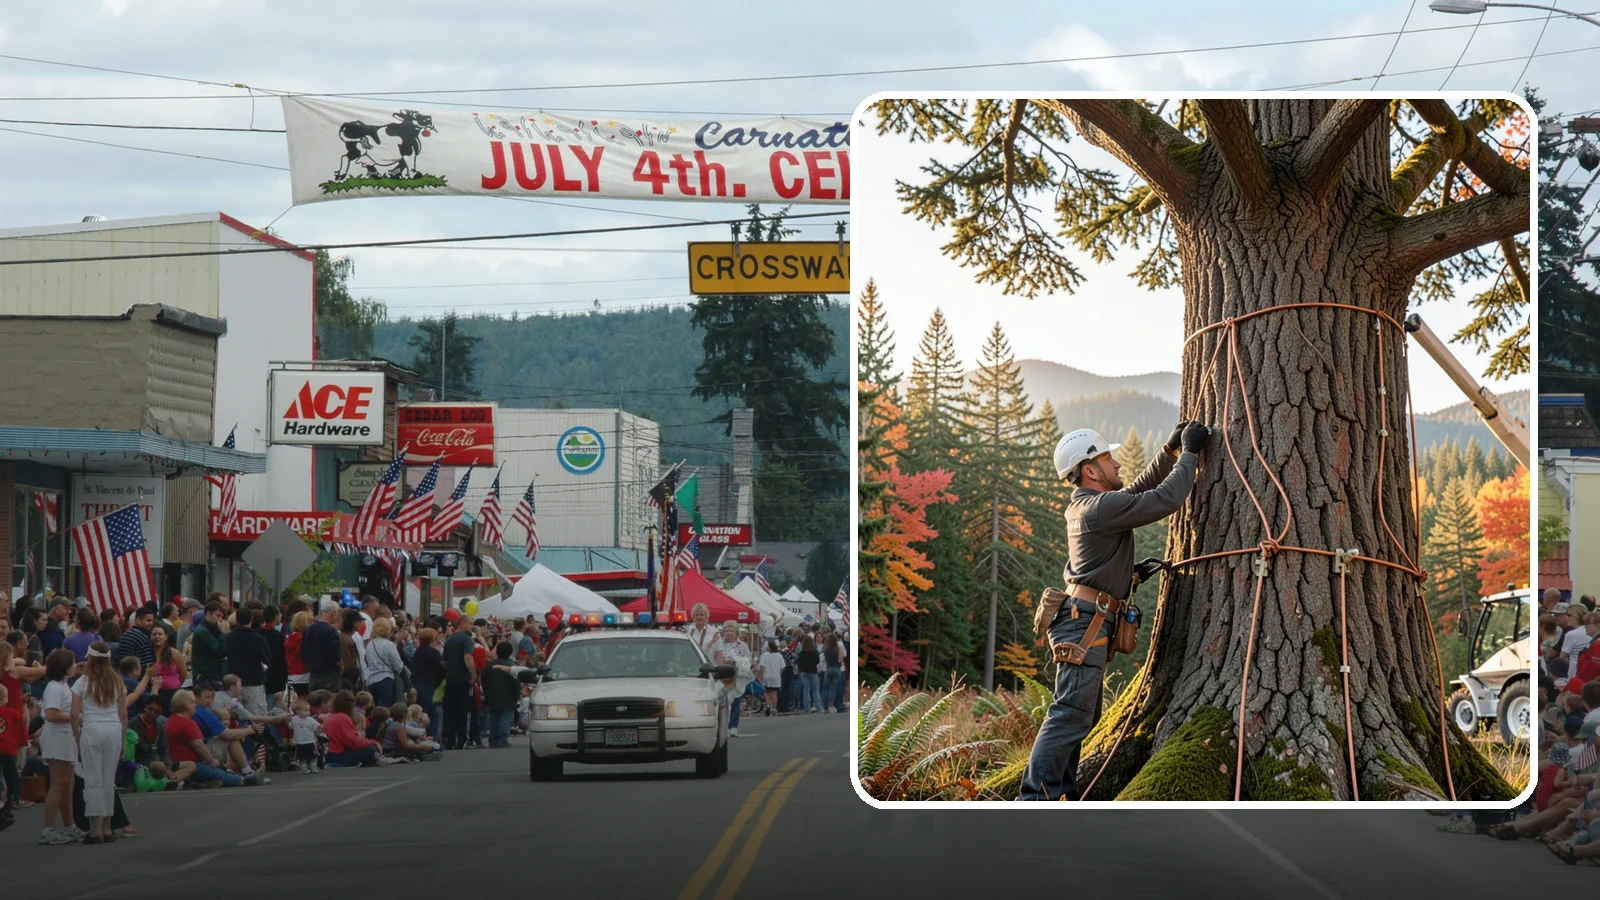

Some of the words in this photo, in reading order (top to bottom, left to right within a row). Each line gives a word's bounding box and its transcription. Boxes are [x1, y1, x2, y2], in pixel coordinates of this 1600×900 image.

[481, 140, 605, 193] JULY
[632, 149, 746, 198] 4th.
[697, 254, 850, 280] CROSSWA
[282, 379, 374, 420] ACE
[406, 409, 452, 422] CEDAR
[461, 409, 485, 422] LOG
[283, 421, 371, 437] Hardware
[416, 428, 477, 447] Coca-Cola
[95, 485, 124, 495] Vincent
[126, 486, 136, 495] de
[138, 486, 155, 495] Paul
[688, 526, 741, 535] CRNATION
[699, 535, 730, 543] GLASS
